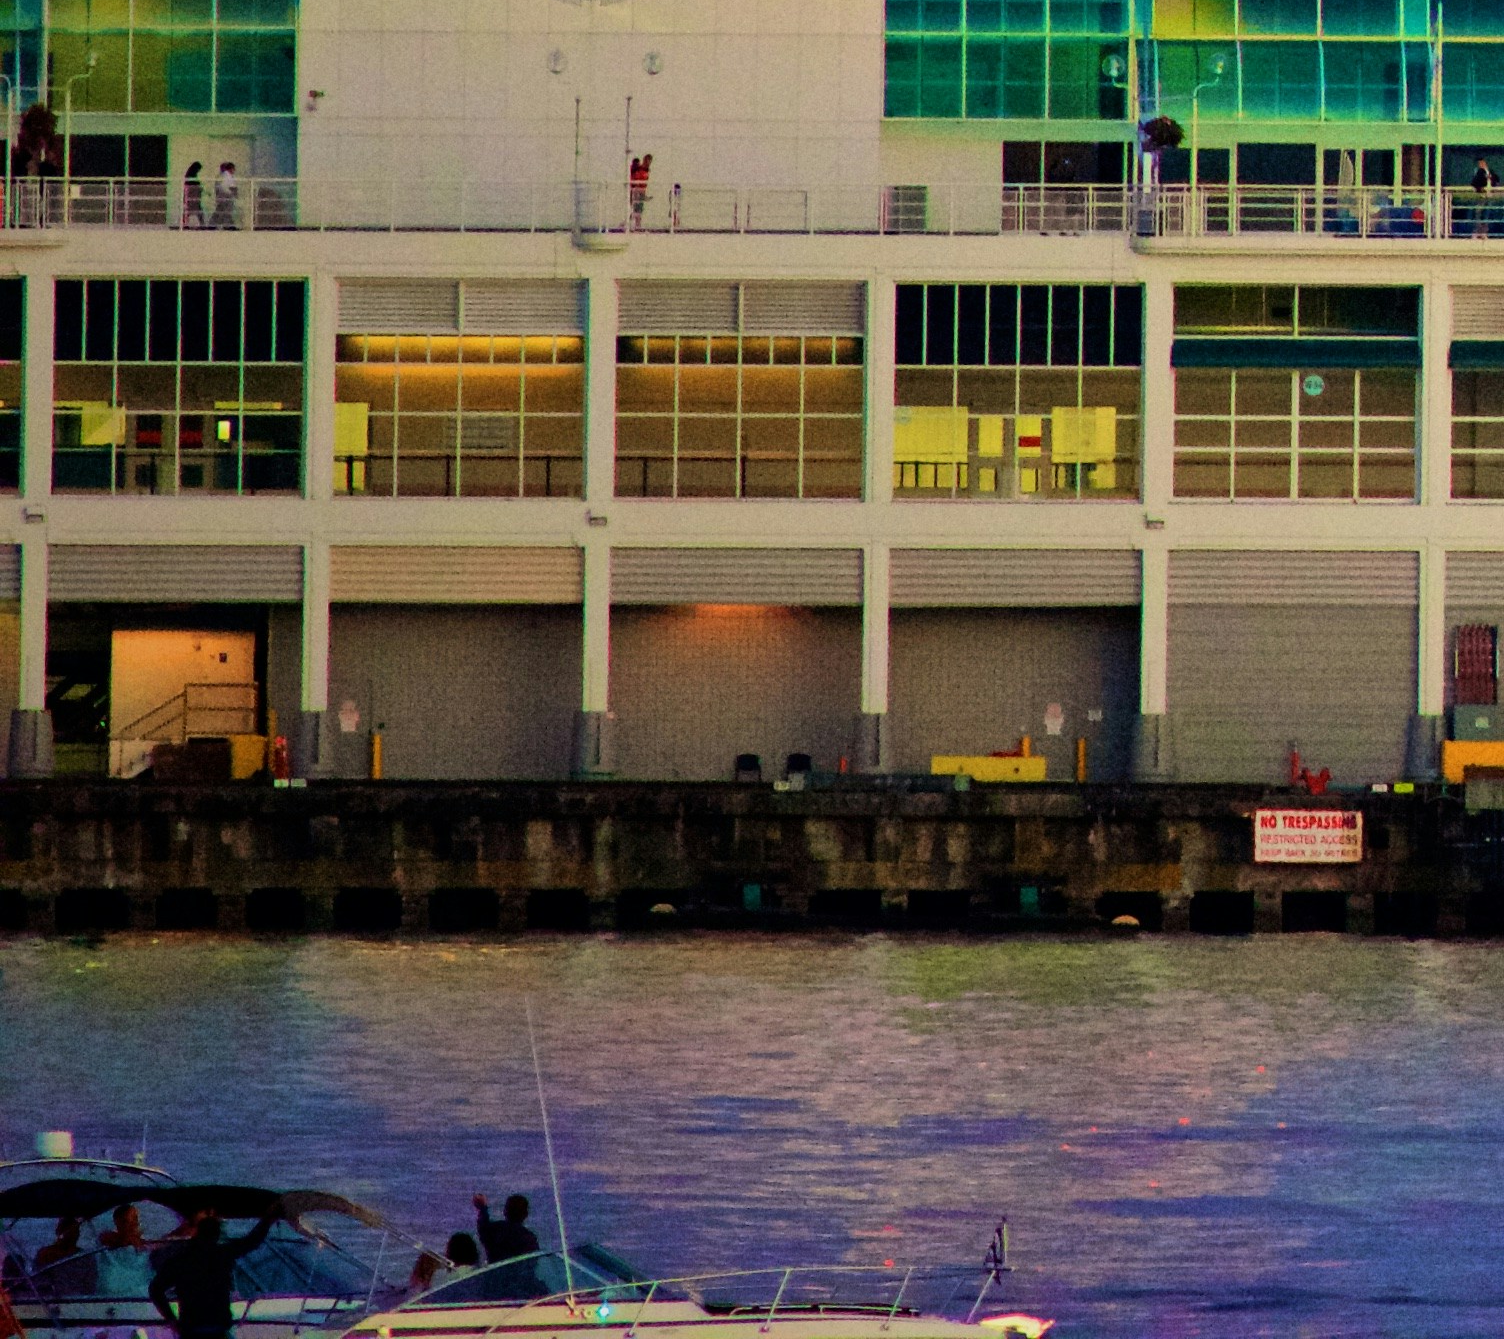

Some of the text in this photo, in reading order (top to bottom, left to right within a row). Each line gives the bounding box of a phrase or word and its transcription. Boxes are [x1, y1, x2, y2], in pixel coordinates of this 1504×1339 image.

[1260, 815, 1357, 829] NO TRESPASSING
[1261, 834, 1357, 844] RESTRICTED ACCESS
